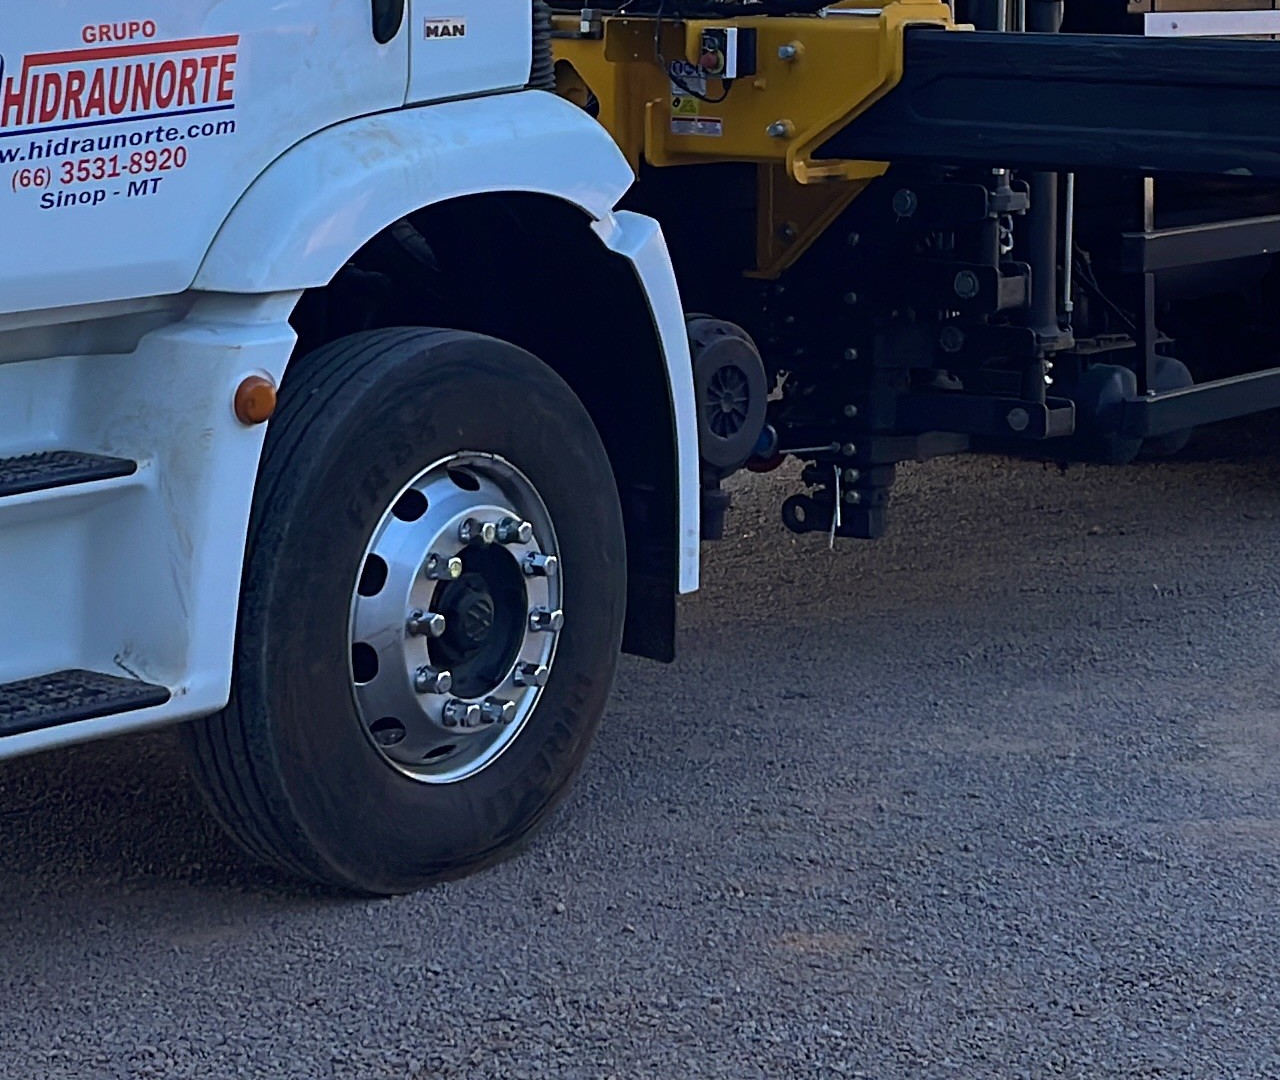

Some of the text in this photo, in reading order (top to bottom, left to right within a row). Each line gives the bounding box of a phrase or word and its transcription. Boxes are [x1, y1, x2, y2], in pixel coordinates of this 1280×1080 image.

[82, 20, 156, 44] GRUPO
[426, 24, 465, 38] MAN
[1, 53, 237, 127] HIDRAUNORTE
[12, 145, 187, 193] (66) 3531-8920
[40, 188, 106, 209] Sinop
[127, 177, 163, 198] MT
